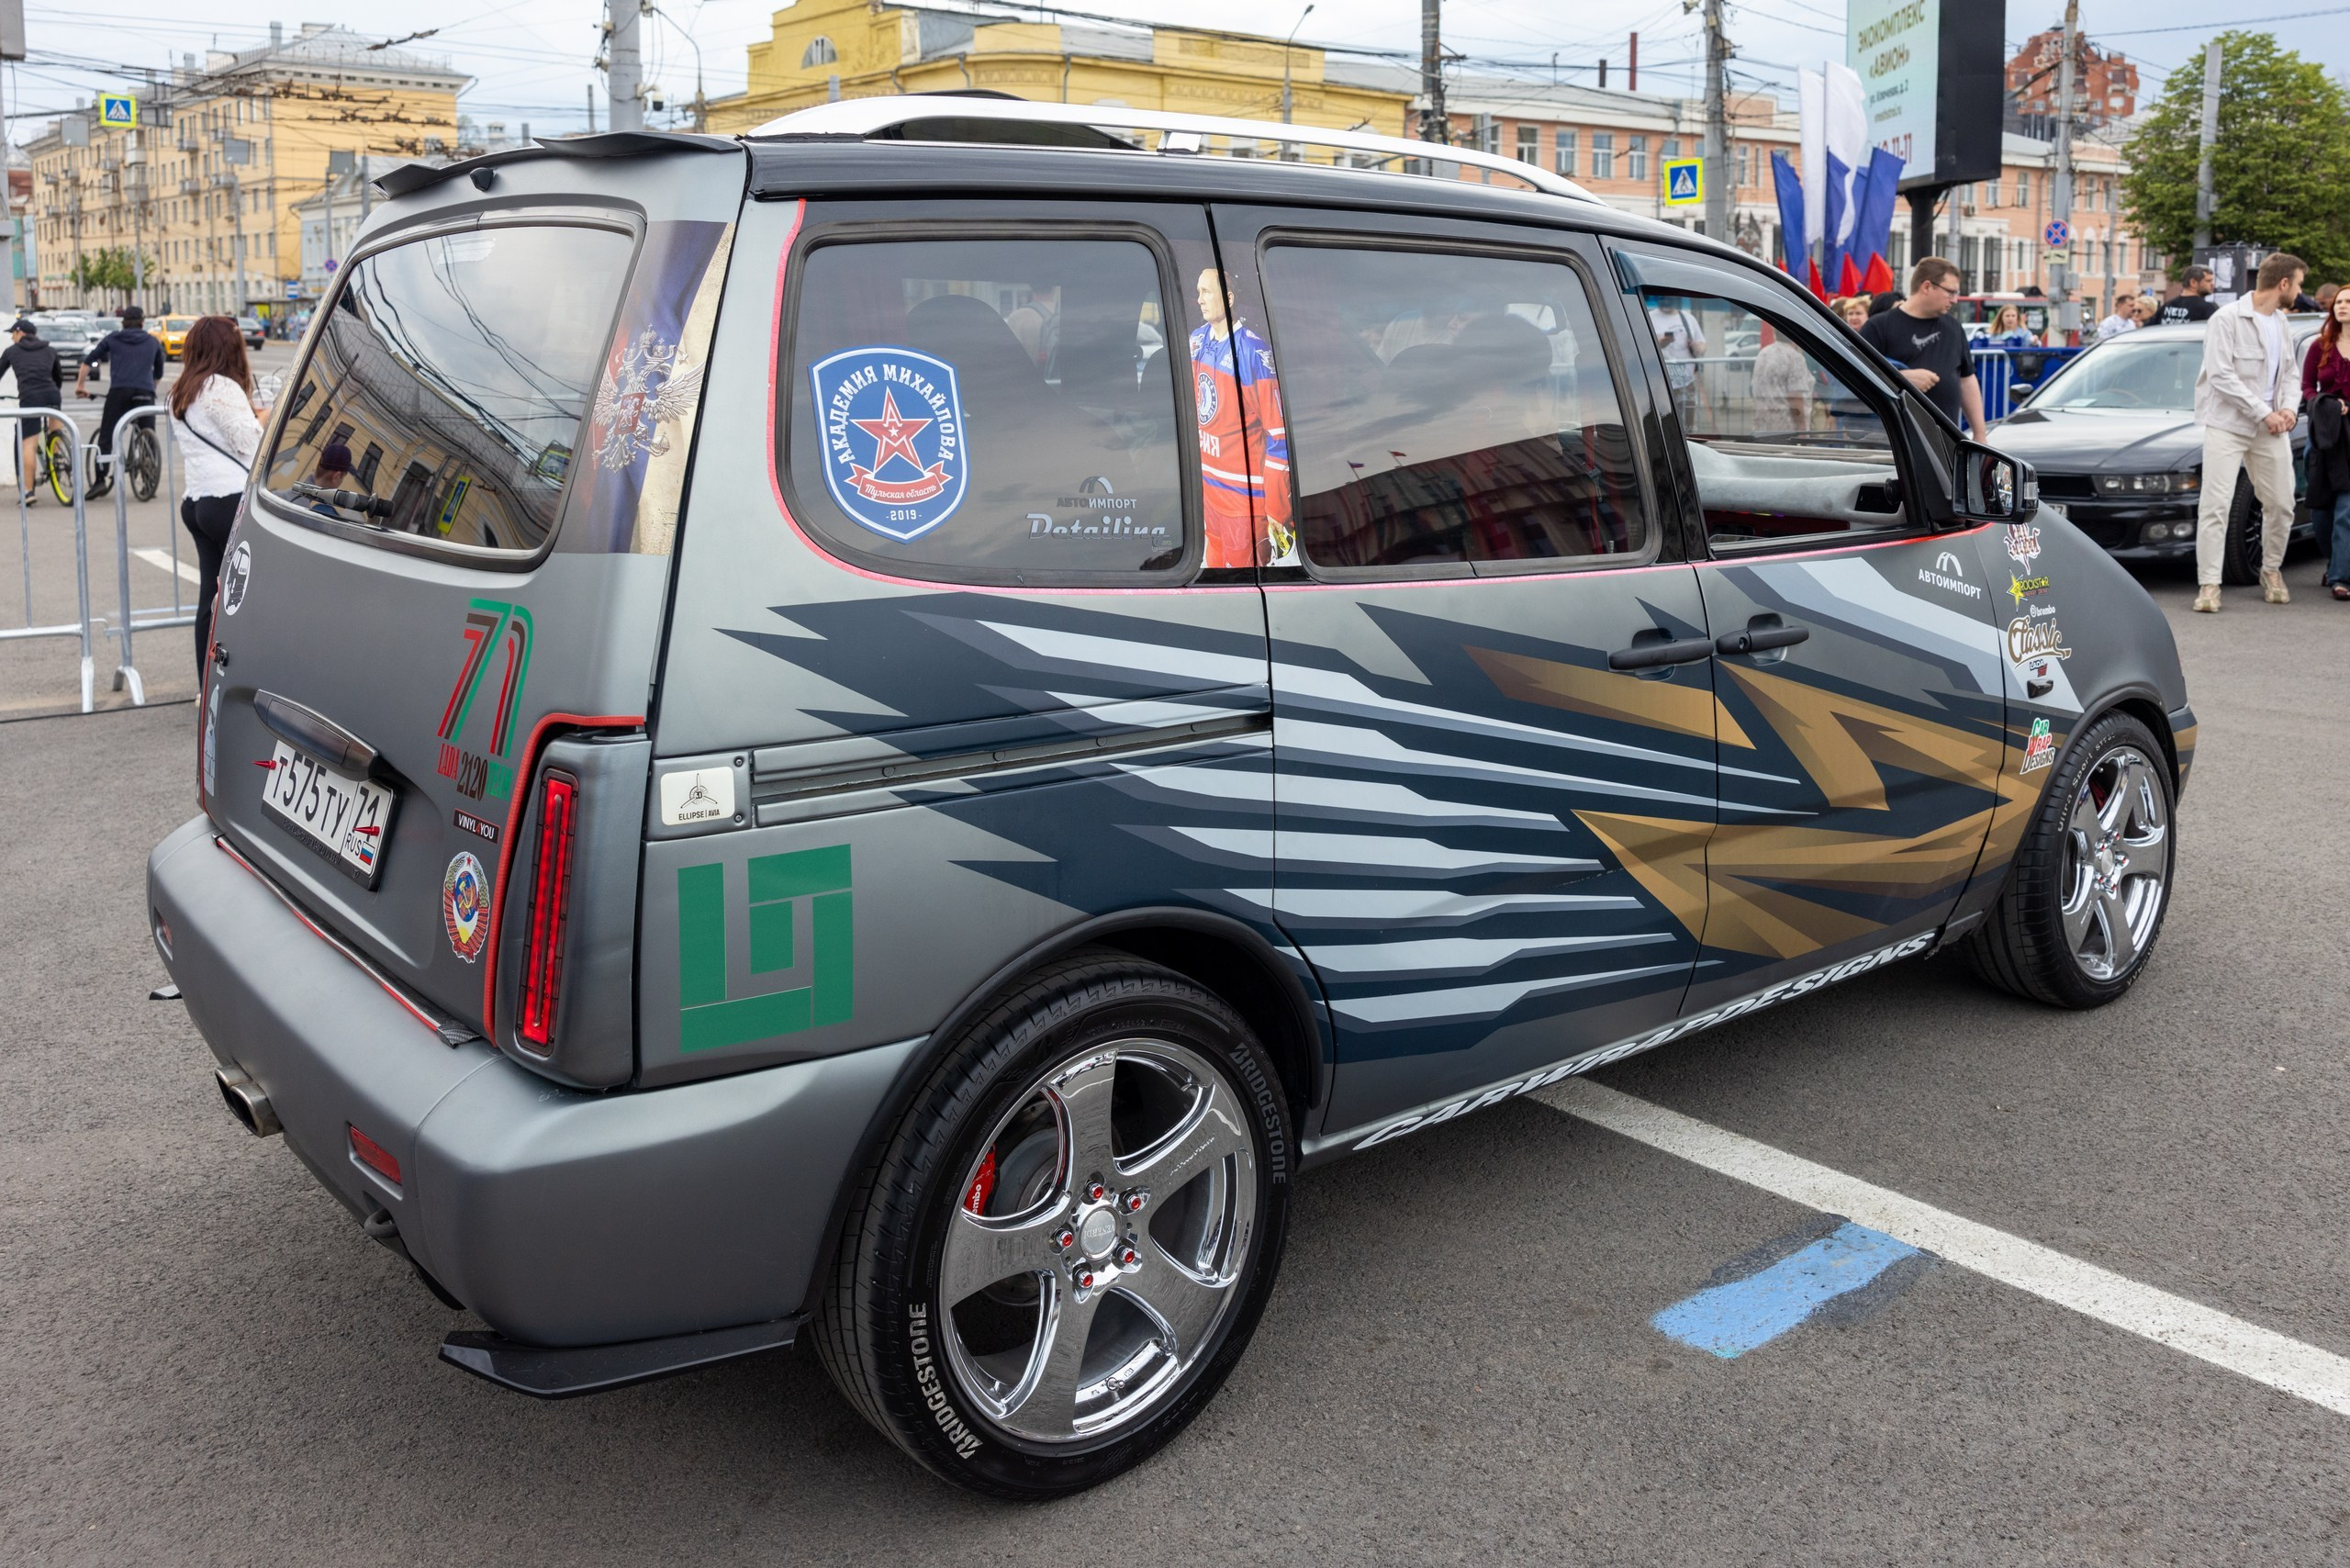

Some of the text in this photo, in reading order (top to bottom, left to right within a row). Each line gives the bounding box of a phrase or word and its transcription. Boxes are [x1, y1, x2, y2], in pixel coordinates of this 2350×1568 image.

[1858, 0, 1925, 52] ЭКОКОМПЛЕКС
[2164, 306, 2189, 318] NEED
[829, 364, 956, 465] АКАДЕМИЯ МИХАЙЛОВА
[865, 483, 937, 499] Тульская область
[1025, 513, 1169, 547] Detailing
[1918, 568, 1982, 600] АВТОИМПОРТ
[2036, 605, 2056, 616] brembo
[2008, 615, 2072, 665] Classic
[2030, 659, 2045, 671] LADA
[2031, 718, 2050, 736] CAR
[2020, 747, 2055, 774] DESIGNS
[2028, 734, 2052, 756] WRAP
[437, 743, 513, 803] LADA 2120 TEAM
[2057, 793, 2073, 833] Ultra
[2072, 752, 2094, 789] Sport
[352, 786, 380, 843] 71
[458, 812, 496, 840] VINYL4YOU
[678, 809, 721, 821] ELLIPSE AVIA
[344, 832, 363, 857] RUS
[1352, 932, 1936, 1151] CARWRAPDESIGNS
[1228, 1041, 1286, 1185] BRIDGESTONE
[908, 1301, 984, 1460] BRIDGESTONE
